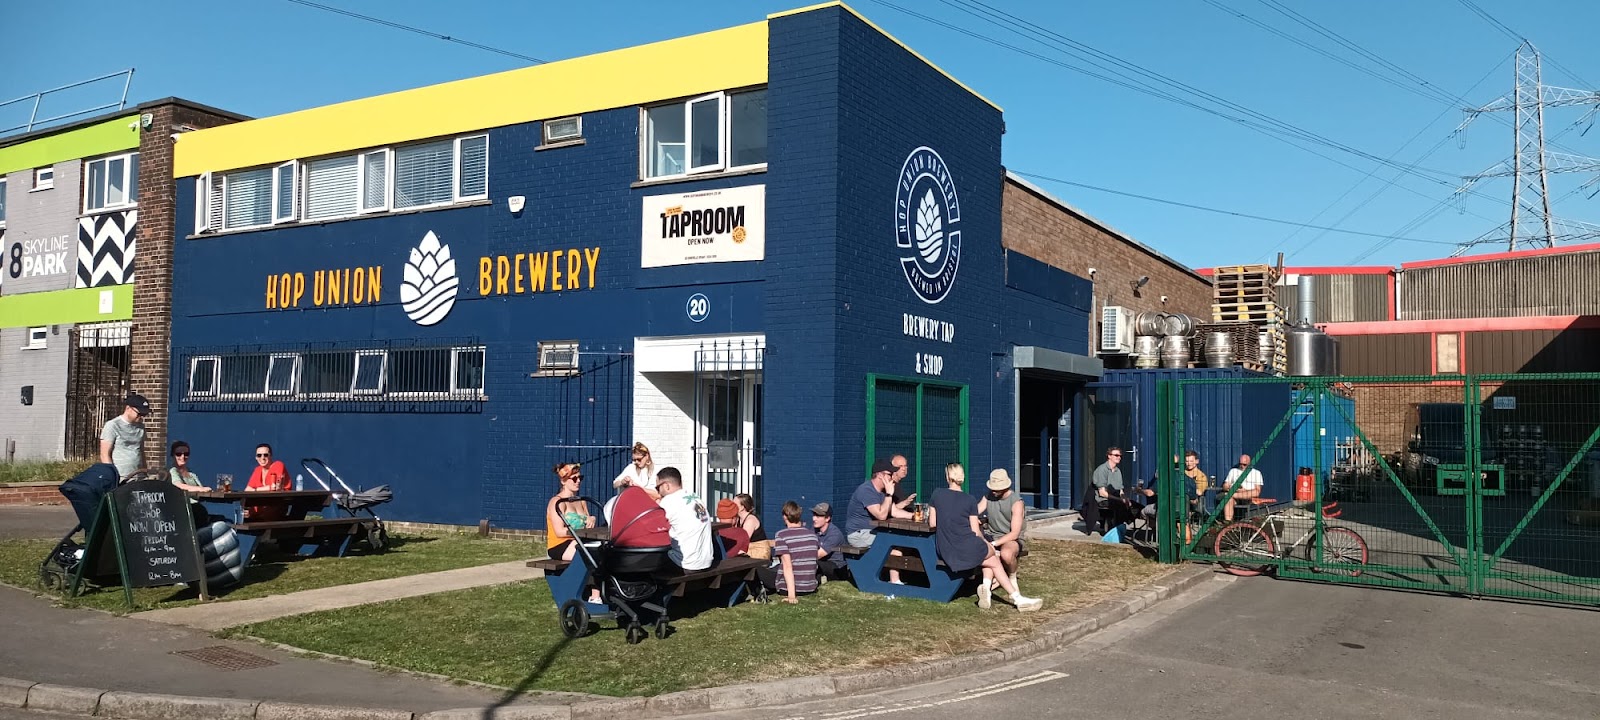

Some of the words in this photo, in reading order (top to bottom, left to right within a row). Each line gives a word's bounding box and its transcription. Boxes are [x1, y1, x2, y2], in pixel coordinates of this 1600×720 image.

[902, 154, 924, 192] UNION
[927, 155, 956, 210] BREWERY
[660, 205, 745, 239] TAPROOM
[899, 199, 907, 233] HOP
[23, 234, 69, 255] SKYLINE
[687, 238, 701, 246] OPEN
[702, 237, 715, 245] NOW
[9, 242, 23, 279] 8
[23, 251, 68, 278] PARK
[911, 267, 933, 295] BREWED
[934, 281, 942, 294] IN
[942, 244, 958, 287] BRISTOL
[266, 272, 305, 309] HOP
[313, 265, 381, 306] UNION
[479, 247, 600, 296] BREWERY
[690, 298, 707, 316] 20
[903, 312, 939, 341] BREWERY
[940, 321, 955, 343] TAP
[915, 352, 922, 374] &
[923, 353, 943, 376] SHOP
[132, 490, 166, 504] TAPROOM
[140, 508, 161, 519] SHOP
[129, 521, 148, 533] NOW
[154, 520, 176, 533] OPEN
[144, 535, 167, 545] FRIDAY
[148, 556, 177, 567] SATURDAY
